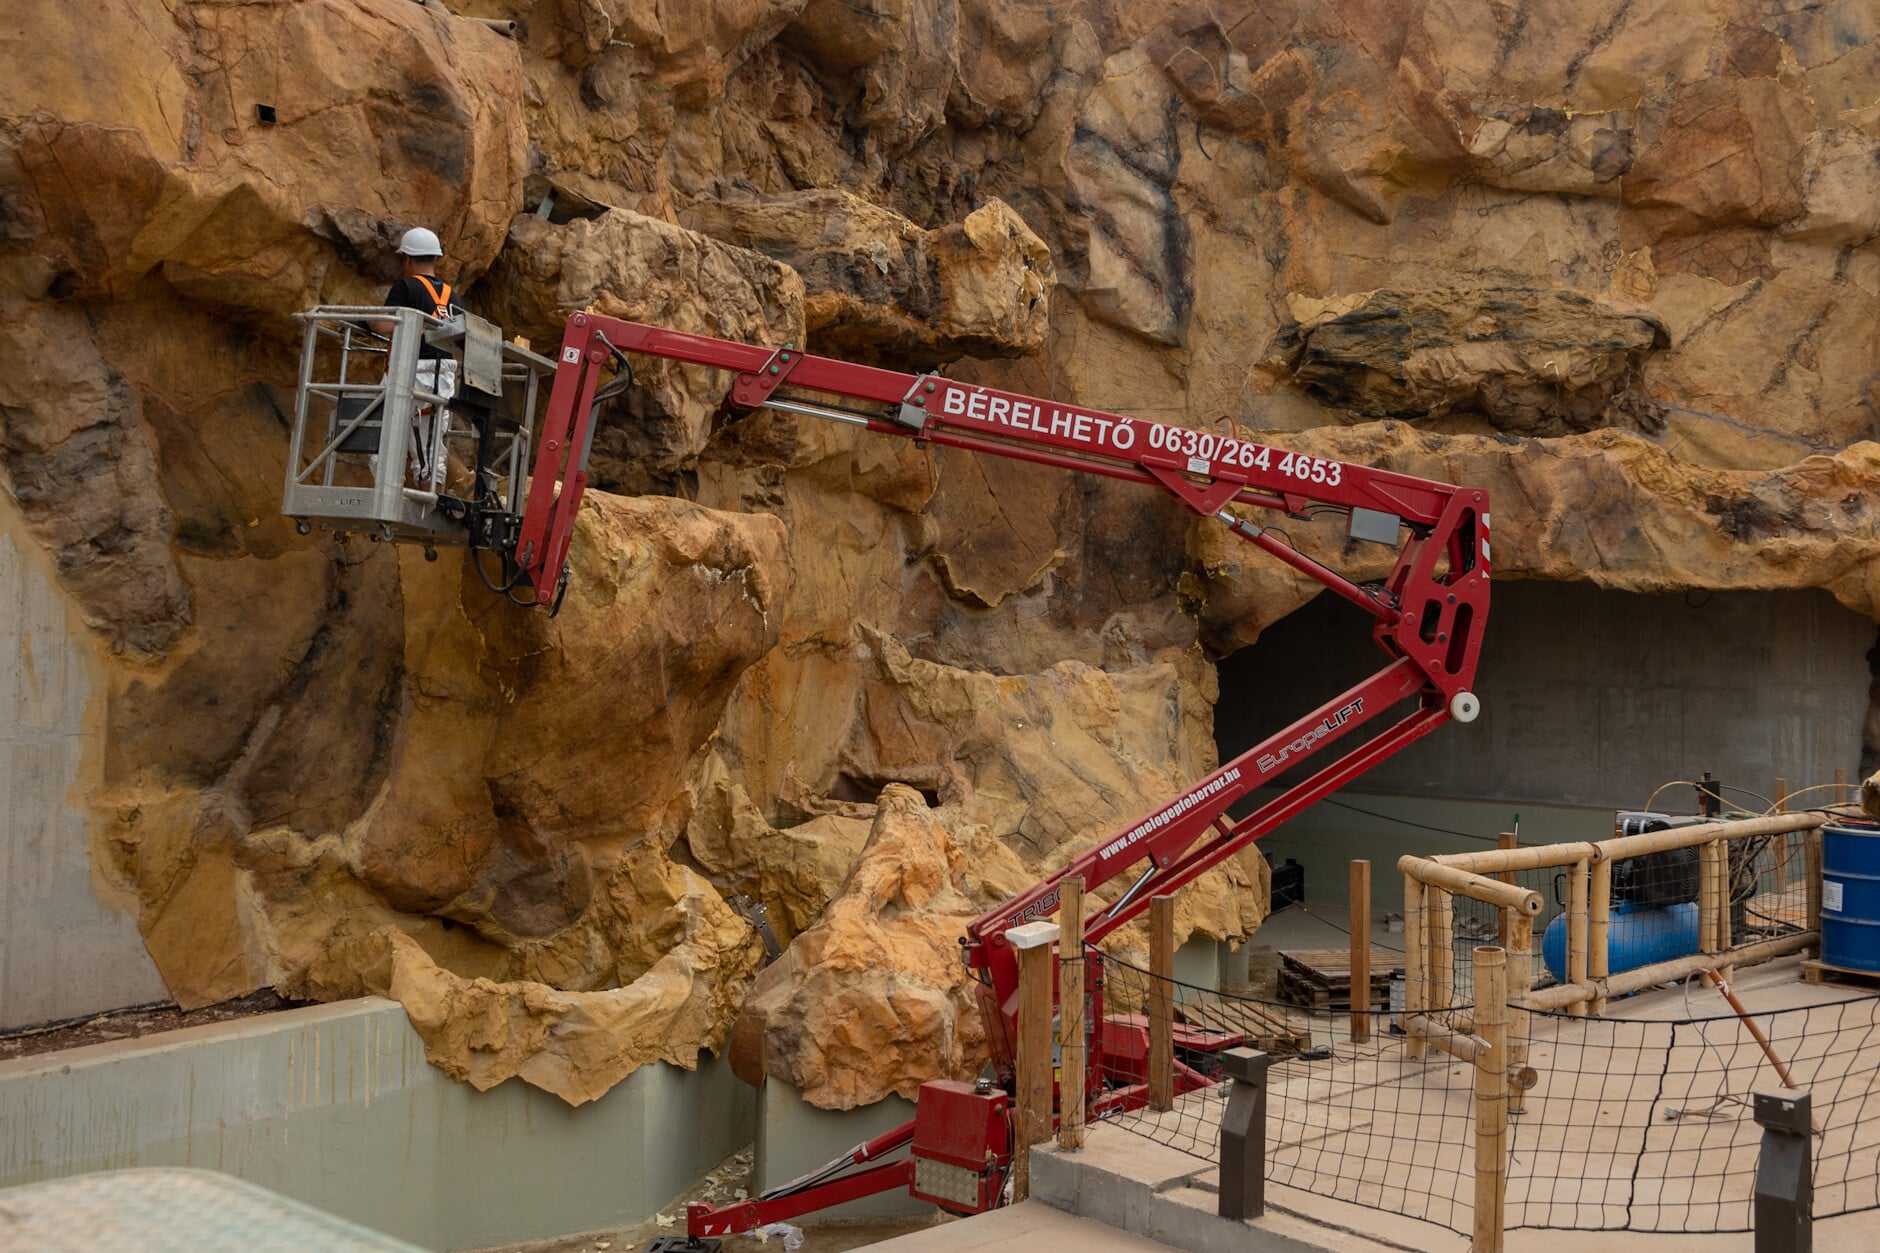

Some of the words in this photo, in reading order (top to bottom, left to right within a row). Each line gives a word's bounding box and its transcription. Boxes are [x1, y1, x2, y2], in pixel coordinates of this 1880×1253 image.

[943, 387, 1135, 450] BÉRELHETŐ
[1149, 423, 1271, 472] 0630/264
[1278, 453, 1342, 487] 4653
[1257, 697, 1363, 773] EuropeLIFT
[1099, 767, 1241, 860] www.emelogepfehervar.hu
